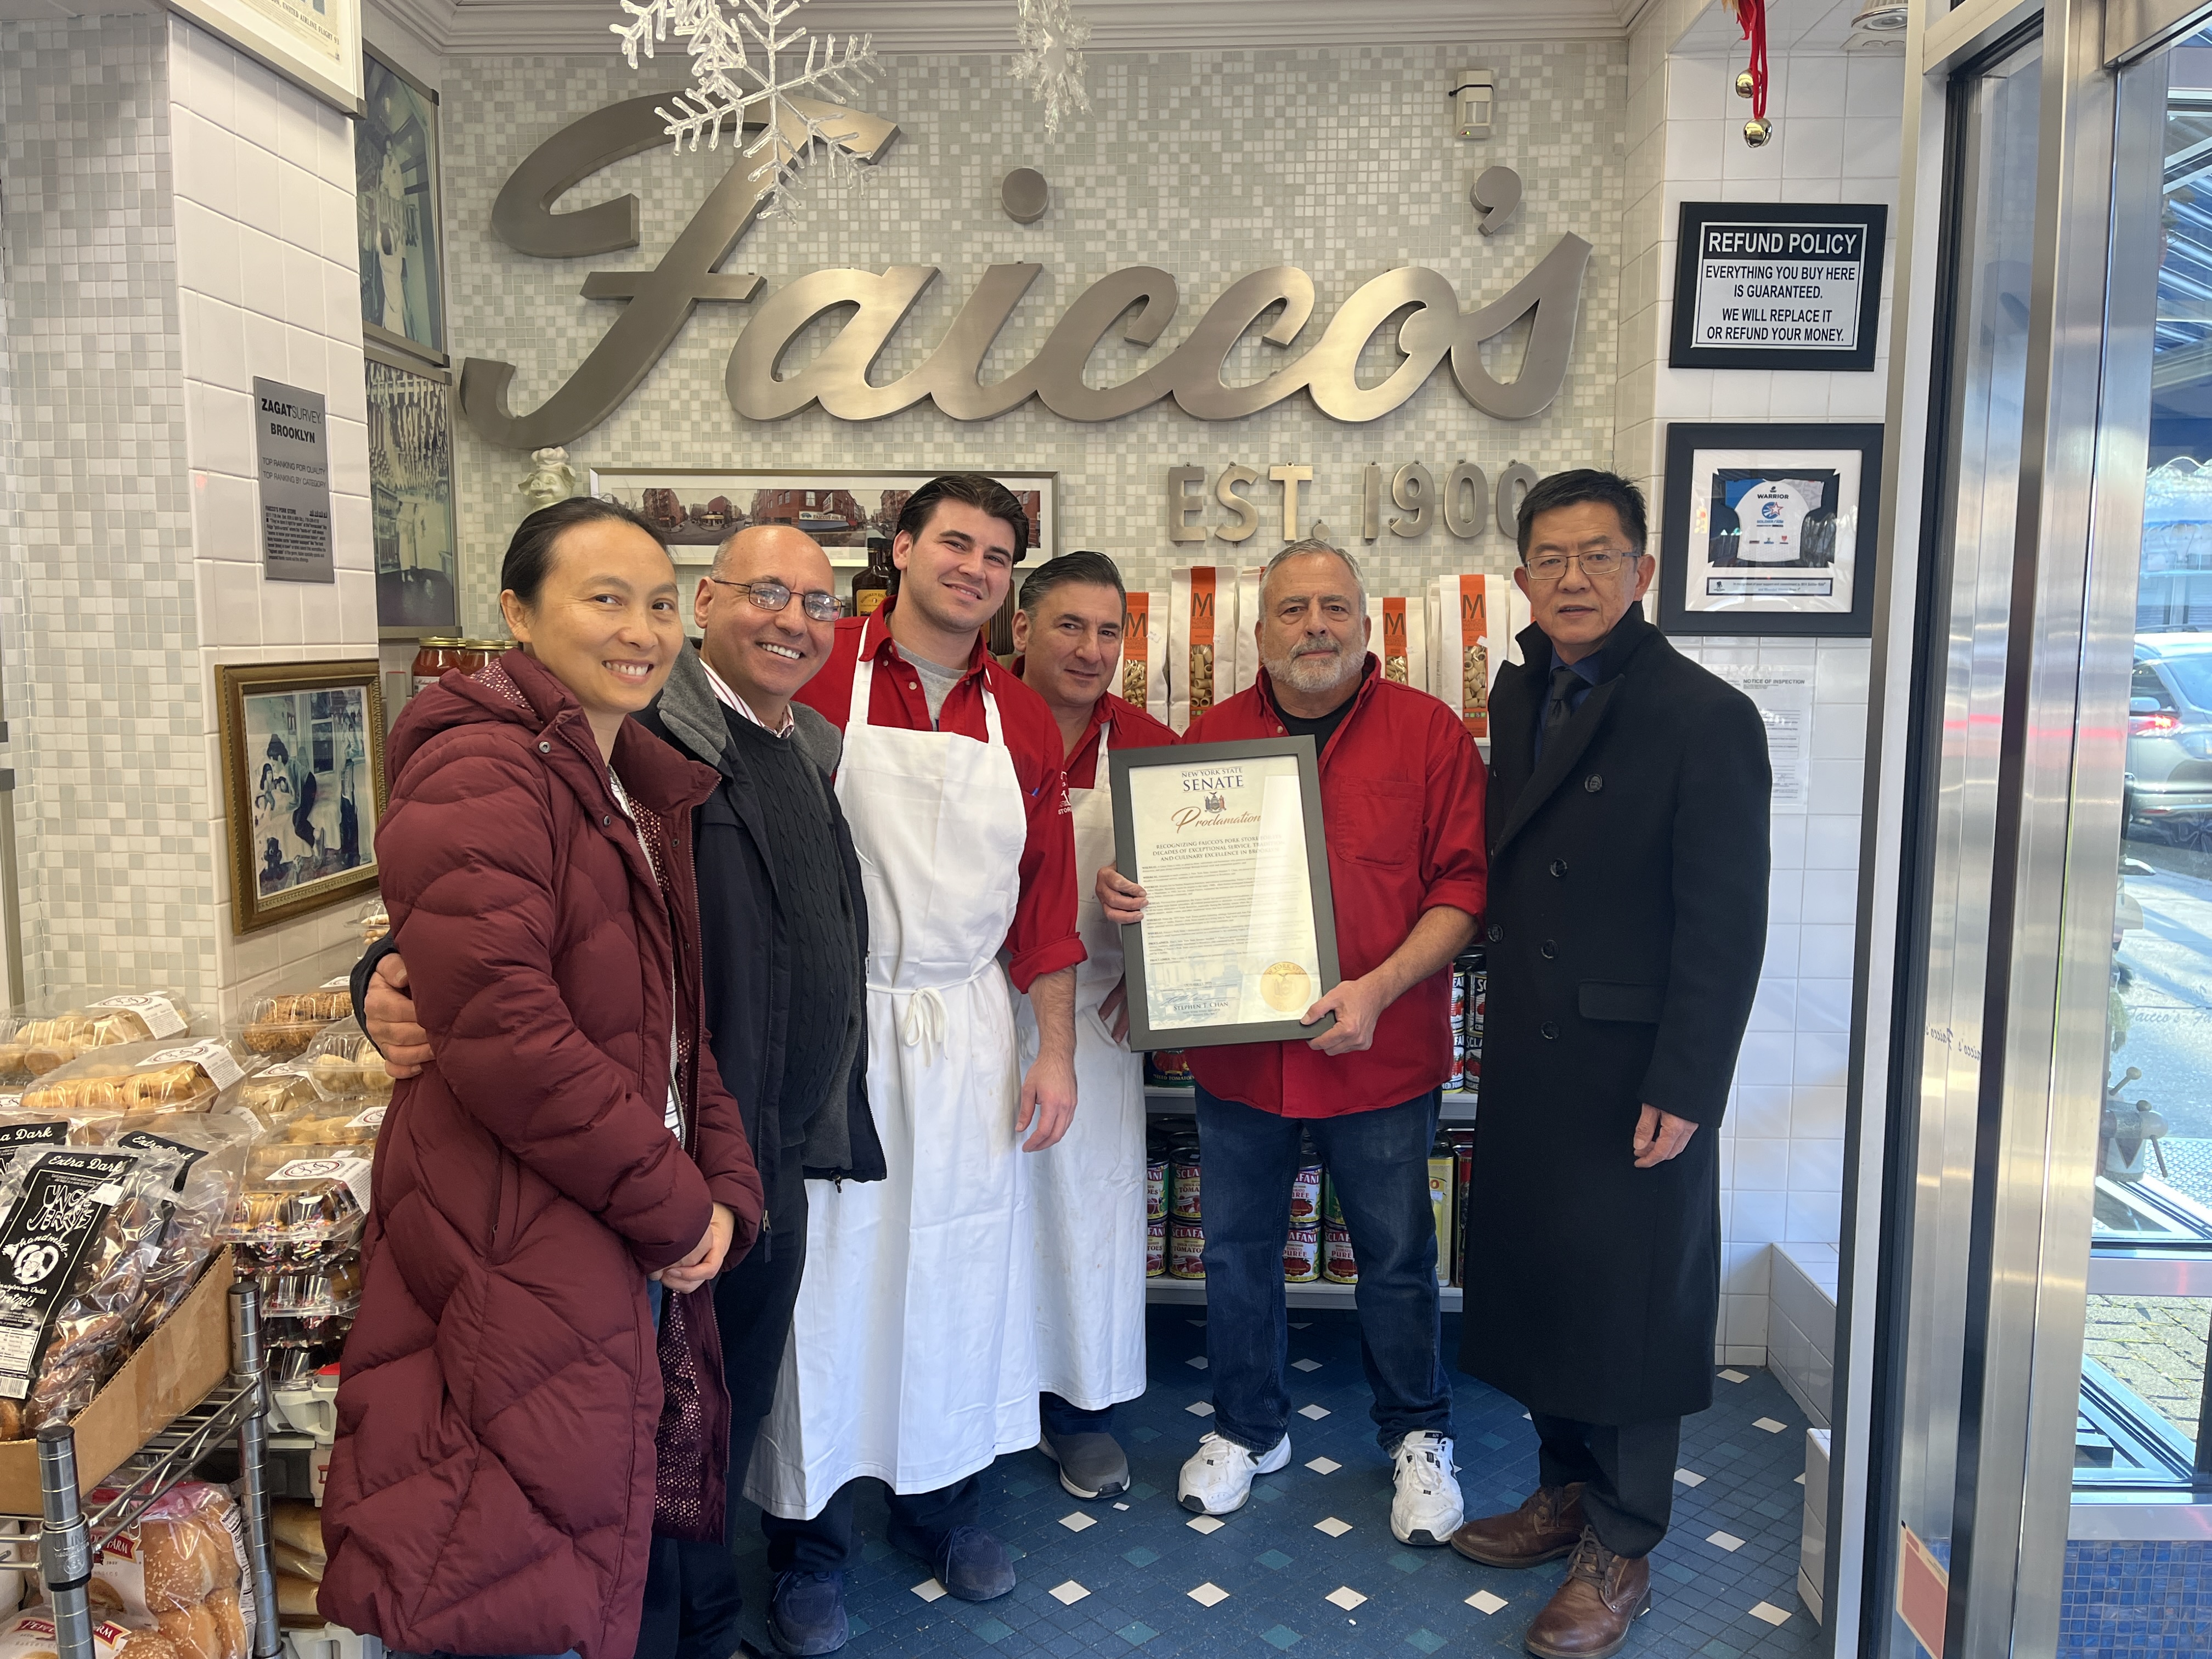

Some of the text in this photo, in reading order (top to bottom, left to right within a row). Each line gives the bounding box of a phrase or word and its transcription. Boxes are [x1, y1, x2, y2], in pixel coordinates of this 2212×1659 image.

[1709, 233, 1857, 253] REFUND POLICY
[460, 89, 1593, 451] Faicco's
[1706, 266, 1855, 280] EVERYTHING YOU BUY HERE
[1734, 284, 1823, 298] IS GUARANTEED.
[1723, 308, 1832, 322] WE WILL REPLACE IT
[1707, 327, 1844, 341] OR REFUND YOUR MONEY.
[270, 422, 315, 443] BROOKLYN
[262, 457, 325, 475] TOP RANKING FOR QUALITY
[263, 471, 273, 479] TOP
[274, 473, 295, 483] RANKING
[302, 478, 326, 488] CATEGORY
[1169, 462, 1538, 543] EST. 1900
[1192, 593, 1213, 617] M
[1463, 594, 1485, 619] M
[1125, 613, 1147, 637] M
[1385, 613, 1404, 635] M
[1183, 775, 1244, 792] SENATE
[1171, 806, 1261, 834] Proclamation
[1156, 841, 1197, 849] RECOGNIZING
[15, 1127, 53, 1140] Dark
[48, 1155, 123, 1172] Extra Dark
